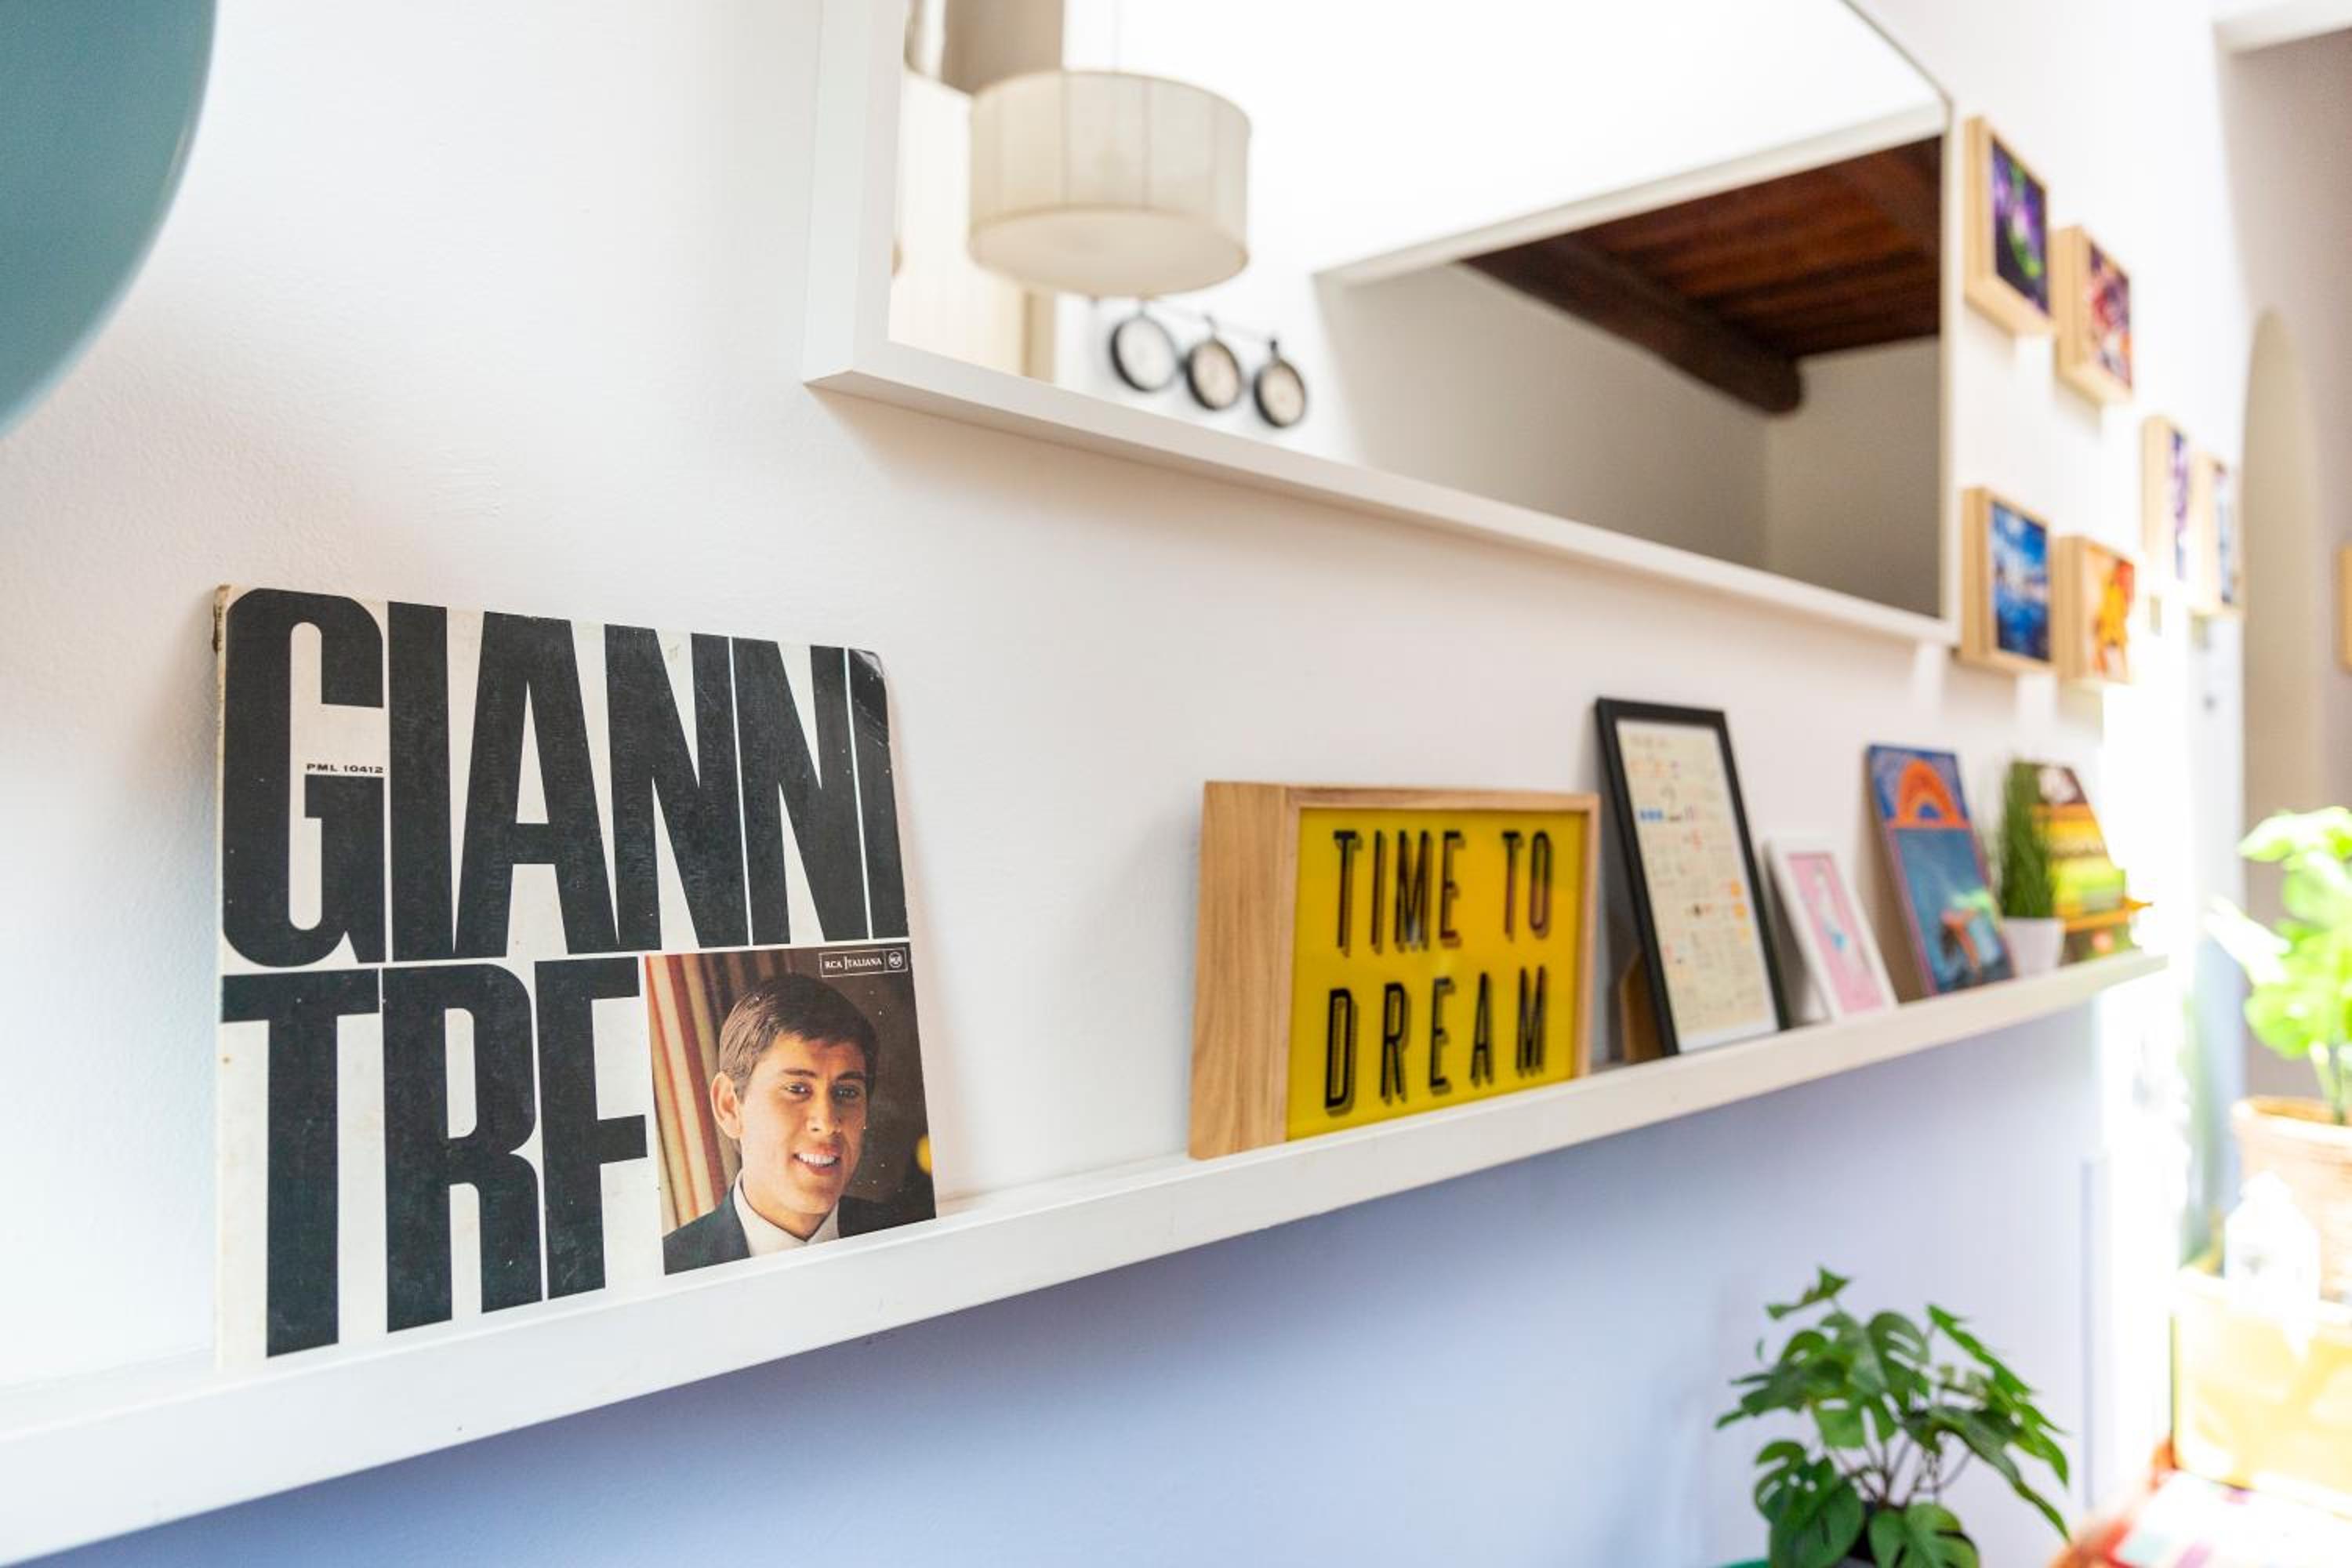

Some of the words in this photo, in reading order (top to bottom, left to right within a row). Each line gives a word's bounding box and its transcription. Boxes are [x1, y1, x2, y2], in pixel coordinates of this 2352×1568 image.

[221, 586, 909, 967] GIANNI
[306, 763, 339, 771] PML
[343, 764, 384, 774] 10412
[1333, 829, 1465, 957] TIME
[1501, 830, 1553, 942] TO
[824, 960, 844, 969] RCA
[1323, 964, 1549, 1118] DREAM
